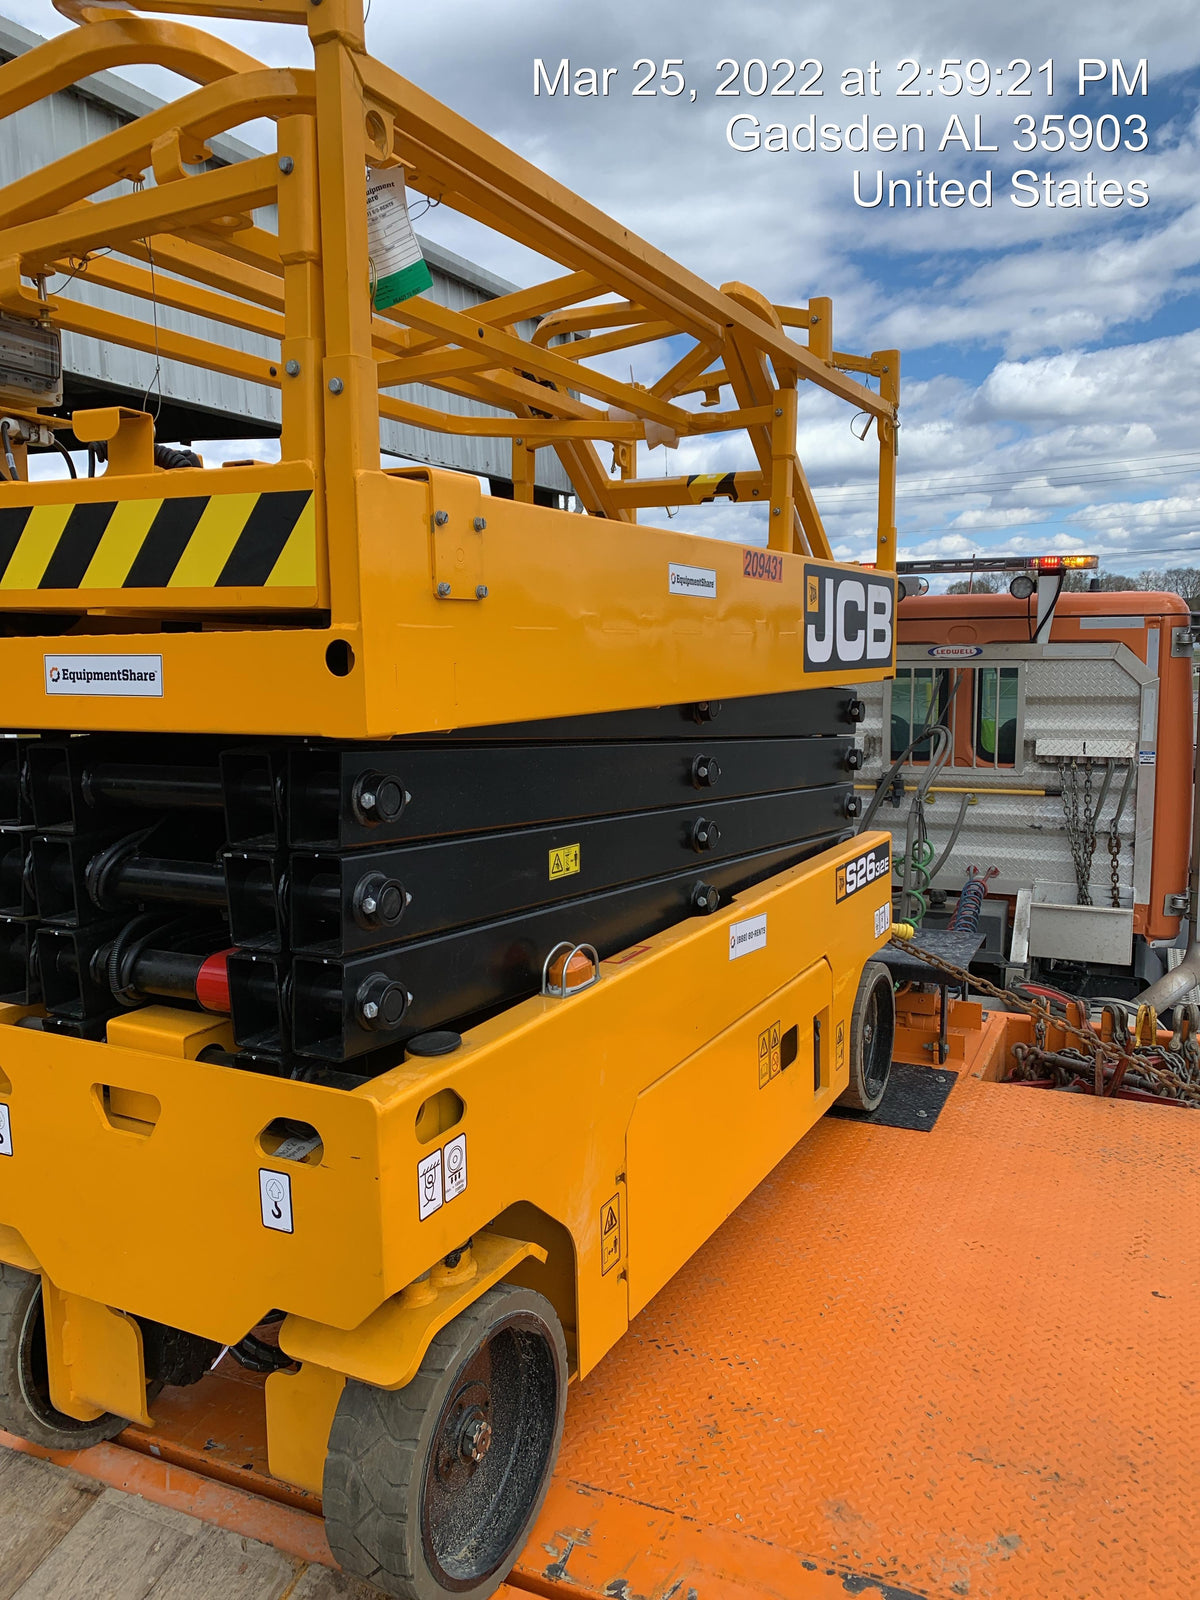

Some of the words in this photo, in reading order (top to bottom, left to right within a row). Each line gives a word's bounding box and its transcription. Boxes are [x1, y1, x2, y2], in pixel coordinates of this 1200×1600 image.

[744, 551, 782, 580] 209431
[676, 574, 715, 589] EquipmentShare
[806, 577, 892, 663] JCB
[61, 668, 156, 683] EquipmentShare
